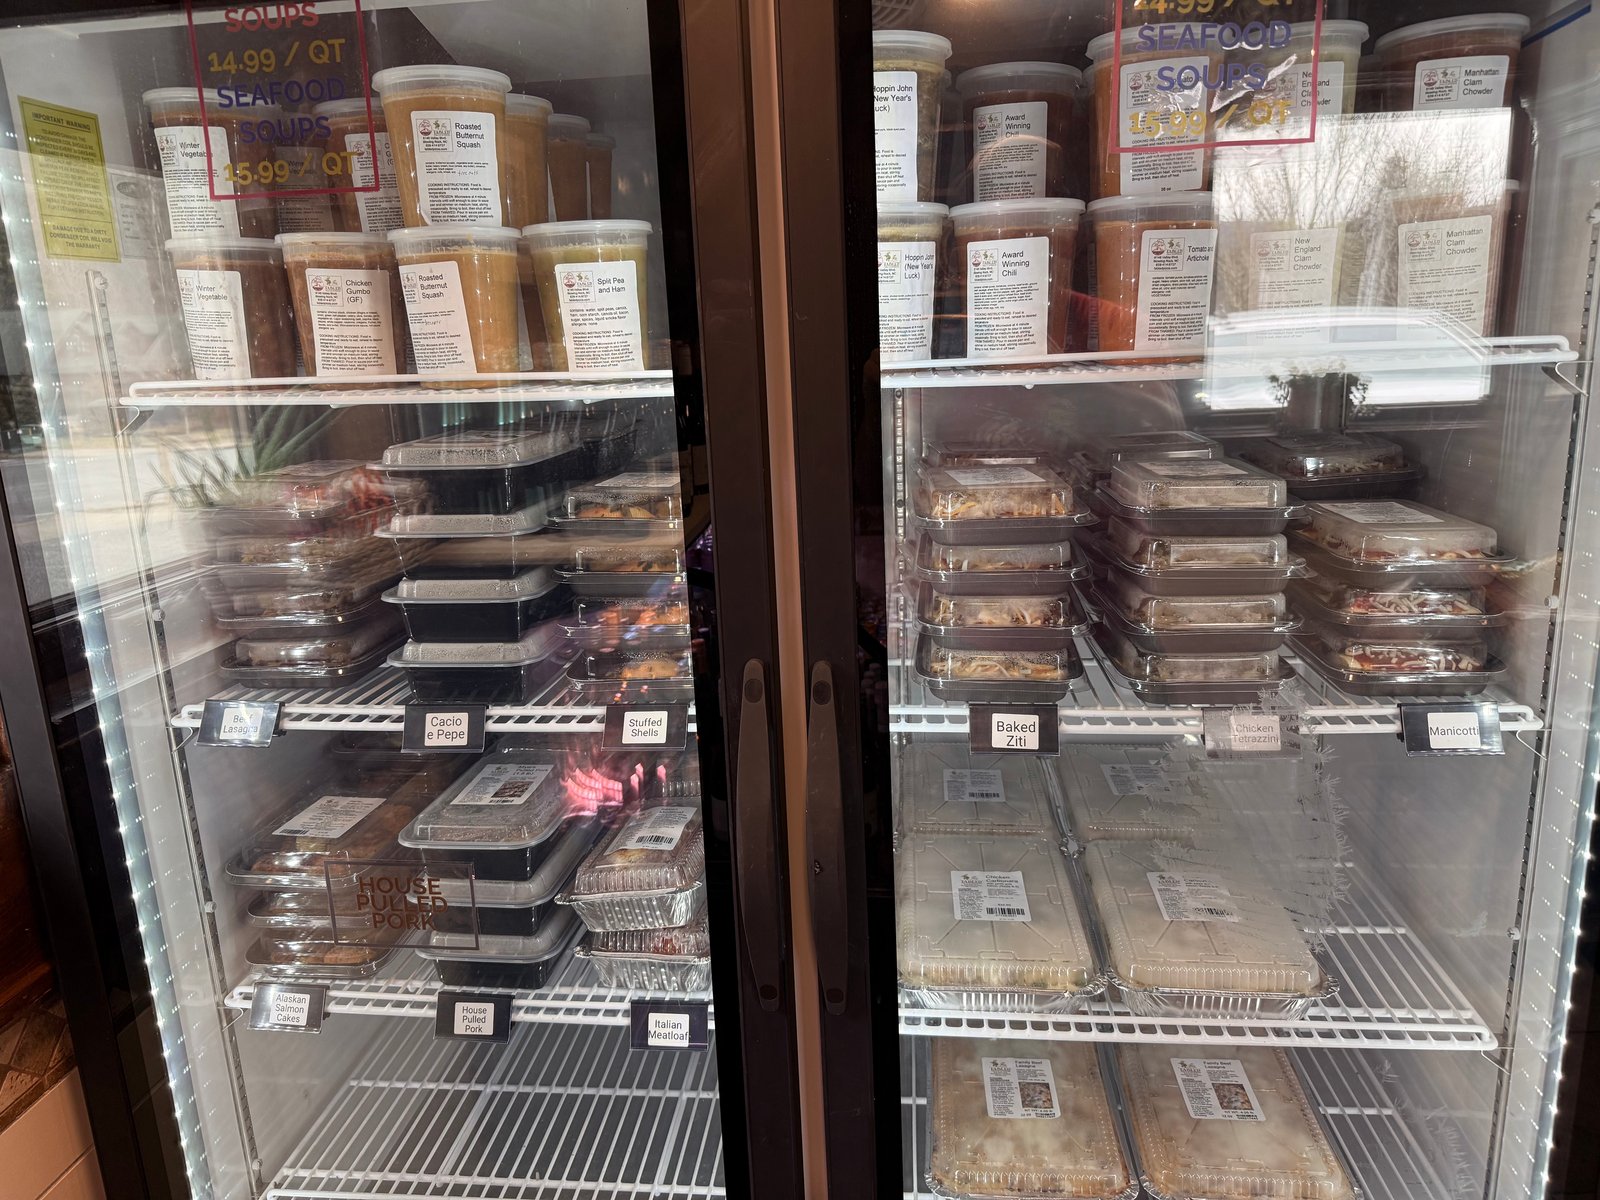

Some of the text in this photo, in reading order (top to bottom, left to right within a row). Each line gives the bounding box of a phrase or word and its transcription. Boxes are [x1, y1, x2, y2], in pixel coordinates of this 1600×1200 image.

[224, 3, 319, 33] SOUPS
[1136, 21, 1292, 51] SEAFOOD
[207, 48, 276, 74] 14.99
[309, 38, 347, 64] QT
[1156, 64, 1268, 91] SOUPS
[1464, 69, 1500, 77] Manhattan
[1302, 79, 1330, 88] Enand
[216, 79, 345, 110] SEAFOOD
[1462, 87, 1494, 96] Chowder
[1301, 98, 1331, 107] Chwder
[875, 104, 890, 113] uck)
[31, 112, 91, 131] IMPORTANT WARNING
[1005, 113, 1026, 122] Award
[1129, 111, 1207, 138] 15.99
[1248, 100, 1292, 127] QT
[239, 117, 332, 145] SOUPS
[455, 131, 484, 140] Butternut
[456, 140, 481, 149] Squash
[223, 160, 289, 187] 15.99
[321, 151, 364, 176] QT
[1446, 228, 1484, 238] Manhattan
[1445, 239, 1465, 247] Clam
[1188, 245, 1207, 253] Tomato
[1294, 245, 1321, 254] England
[1445, 246, 1478, 256] Chowder
[904, 254, 924, 262] Hoppin
[1001, 250, 1024, 259] Award
[1293, 254, 1312, 263] Clam
[904, 262, 919, 270] (New
[1001, 259, 1030, 268] Winning
[1293, 262, 1322, 271] Chowder
[418, 273, 444, 281] Roasted
[904, 272, 920, 280] Luck)
[1001, 269, 1017, 277] Chili
[597, 277, 612, 286] Split
[420, 282, 448, 291] Butternut
[598, 285, 626, 294] and Ham
[197, 293, 228, 301] Vegetable
[347, 296, 363, 304] (GF)
[421, 291, 445, 300] Squash
[430, 716, 462, 727] Cacio
[628, 718, 663, 727] Stuffed
[222, 724, 259, 737] Lasagna
[996, 720, 1037, 733] Baked
[1235, 724, 1274, 733] Chicken
[1430, 726, 1479, 736] Manicotti
[427, 729, 466, 742] e Pepe
[630, 728, 659, 737] Shells
[1006, 735, 1027, 748] Ziti
[1230, 734, 1279, 743] Tetrazzini
[357, 876, 443, 895] HOUSE
[355, 894, 449, 913] PULLED
[373, 913, 437, 932] PORK
[275, 993, 307, 1004] Alaskan
[274, 1003, 305, 1014] Salmon
[461, 1005, 488, 1015] House
[275, 1013, 301, 1023] Cakes
[461, 1015, 486, 1024] Pulled
[654, 1019, 682, 1029] Italian
[464, 1024, 483, 1034] Pork
[648, 1030, 690, 1041] Meatloaf
